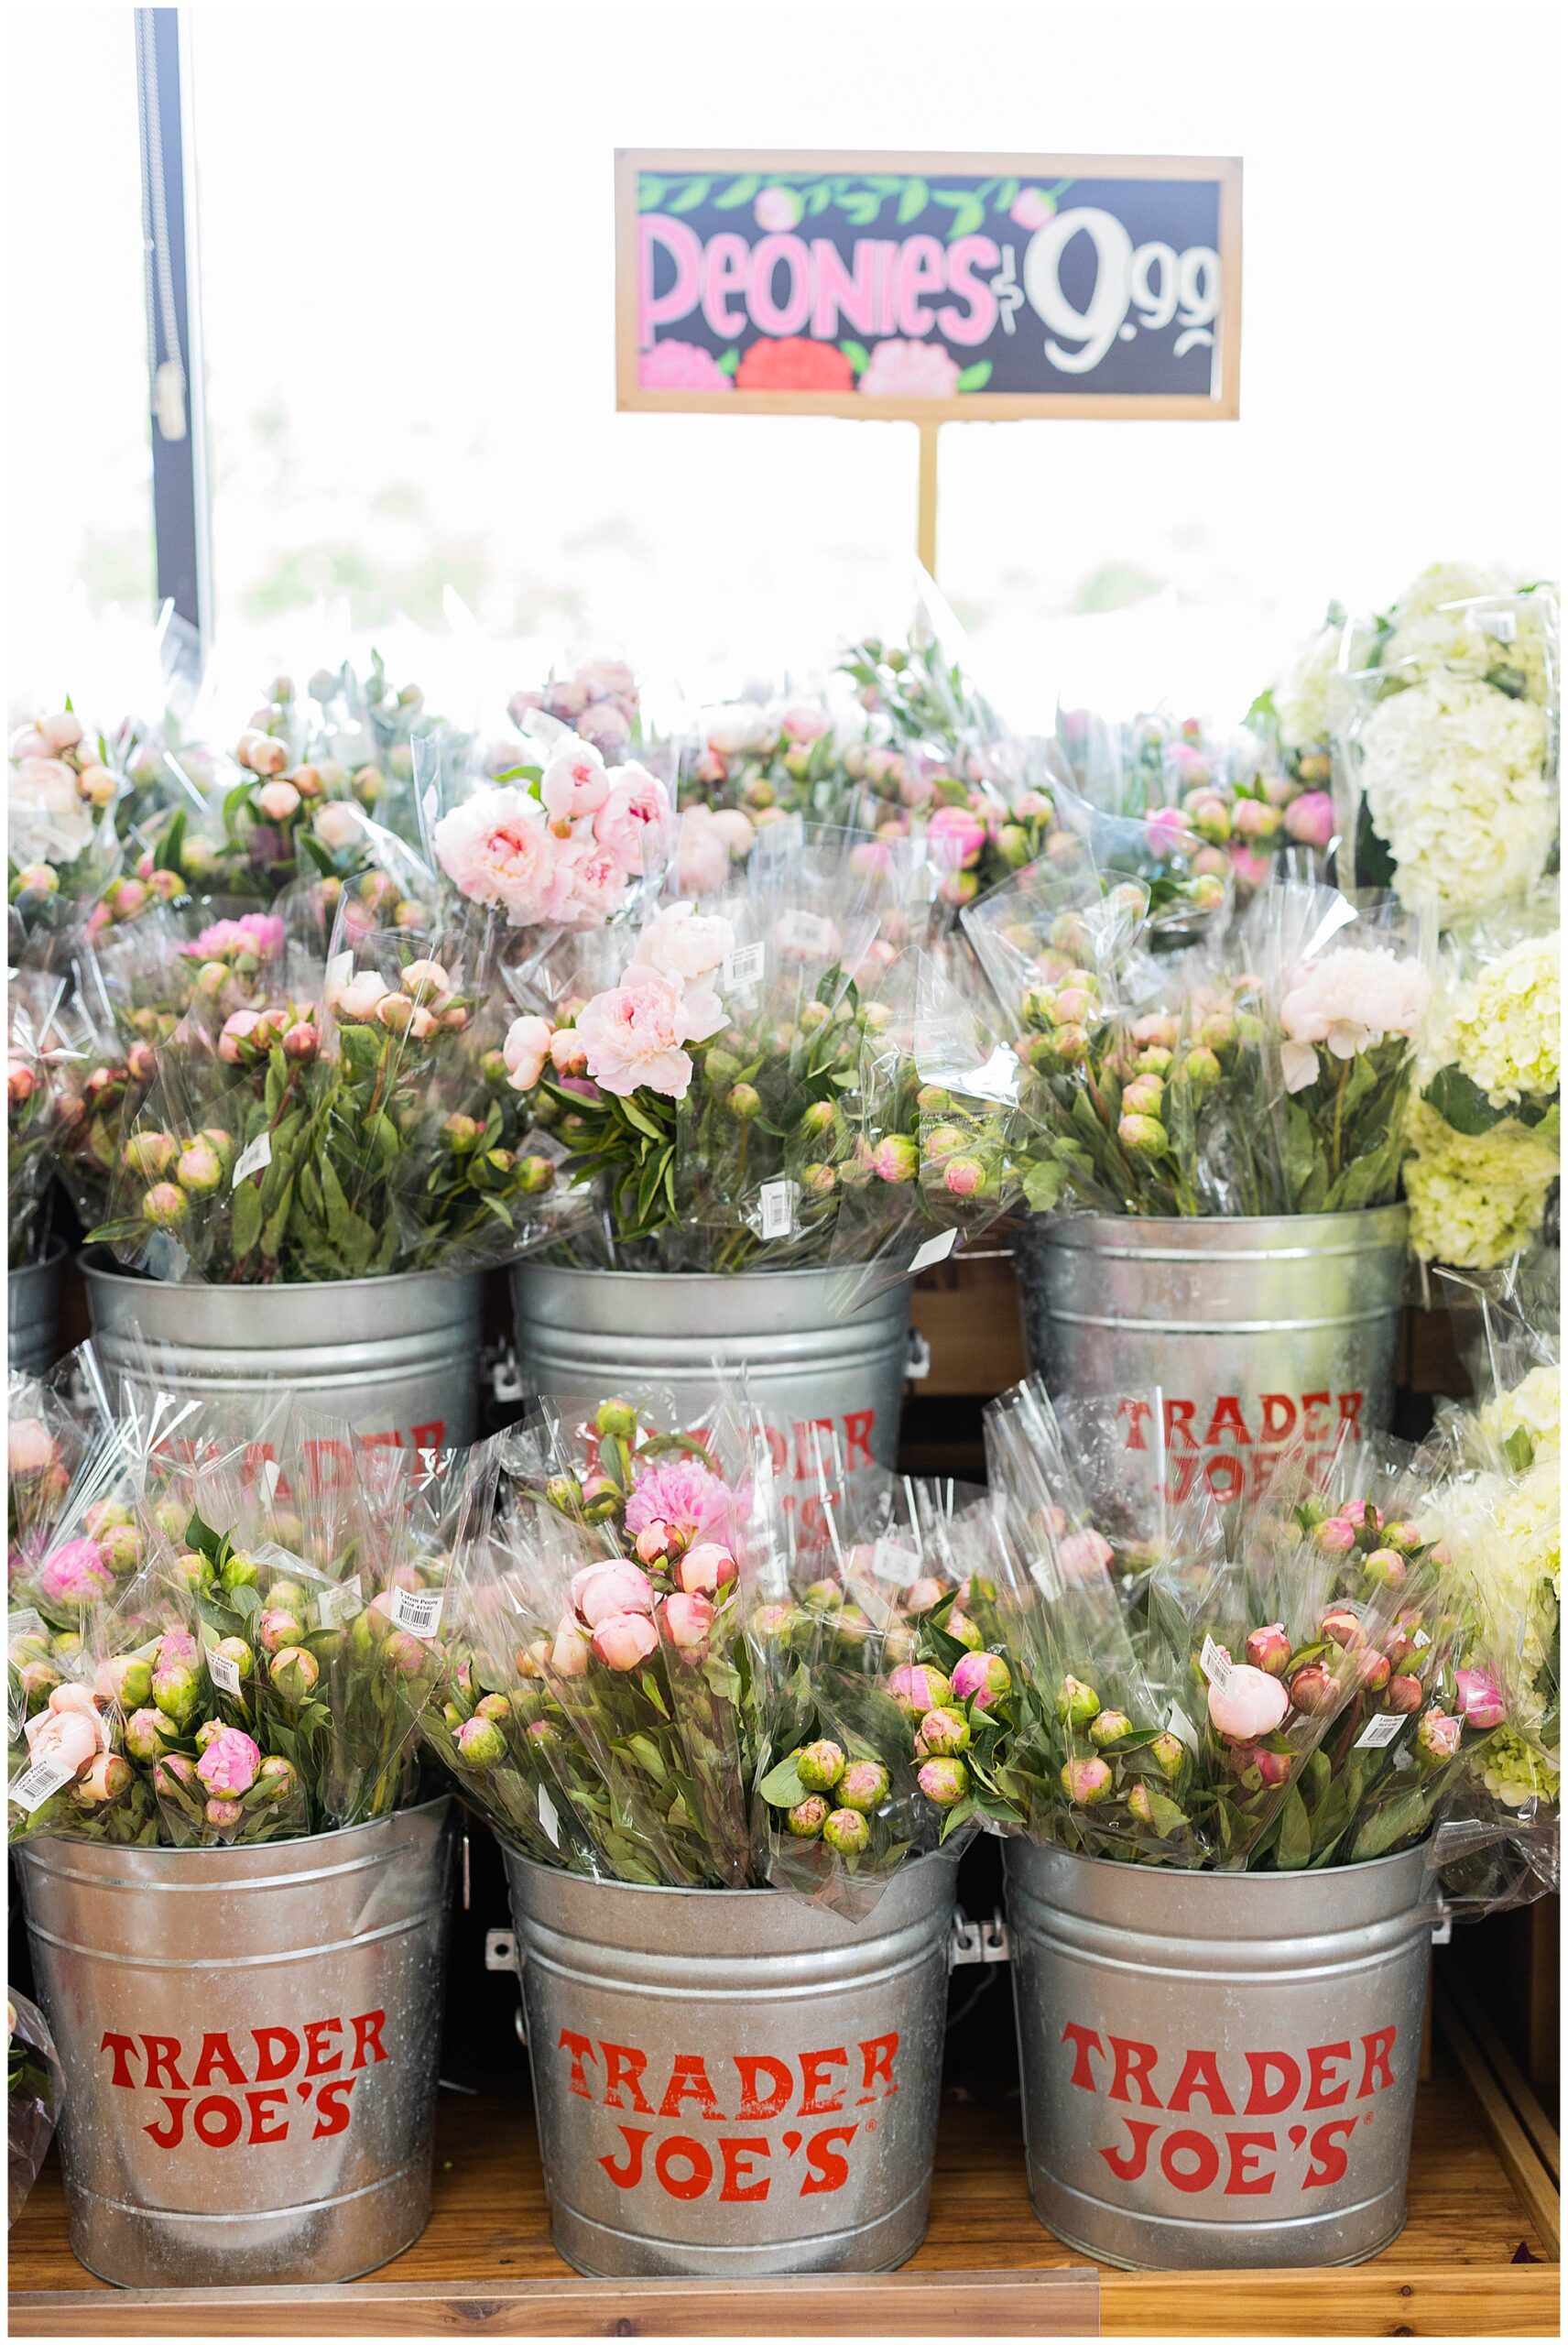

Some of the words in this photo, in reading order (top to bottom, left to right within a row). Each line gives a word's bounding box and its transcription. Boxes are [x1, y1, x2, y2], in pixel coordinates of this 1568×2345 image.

[1116, 1391, 1364, 1451] TRADER
[99, 2009, 389, 2090] TRADER
[557, 2027, 900, 2121] TRADER
[1061, 2021, 1397, 2116] TRADER
[142, 2076, 357, 2150] JOE'S
